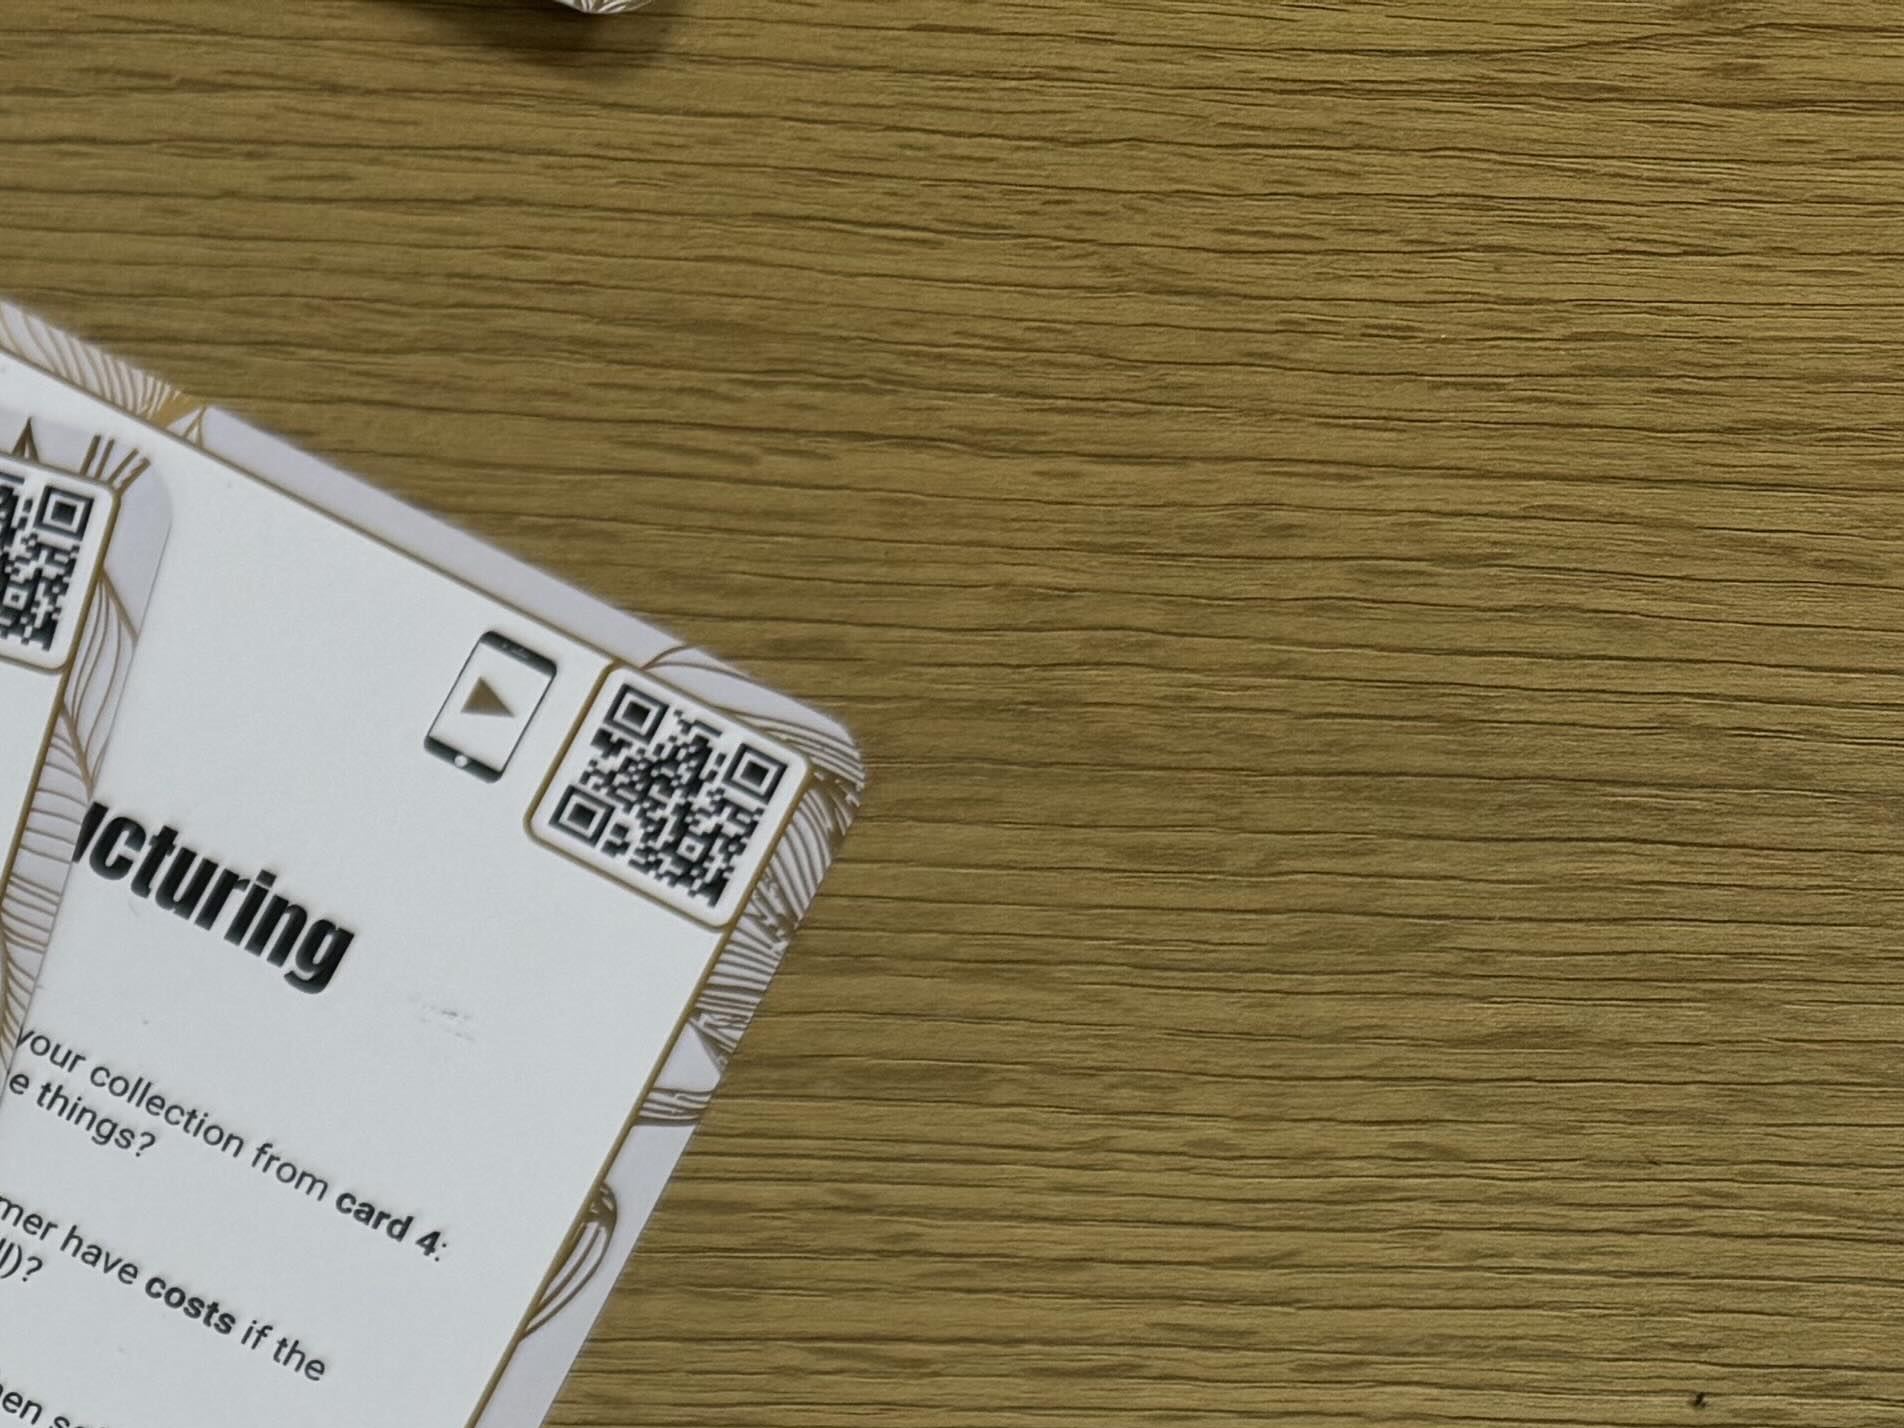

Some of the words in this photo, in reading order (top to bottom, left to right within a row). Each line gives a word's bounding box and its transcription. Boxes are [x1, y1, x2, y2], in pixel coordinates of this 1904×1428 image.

[89, 1065, 245, 1158] collection
[251, 1142, 329, 1202] from
[335, 1192, 415, 1242] card
[415, 1230, 449, 1263] 4:
